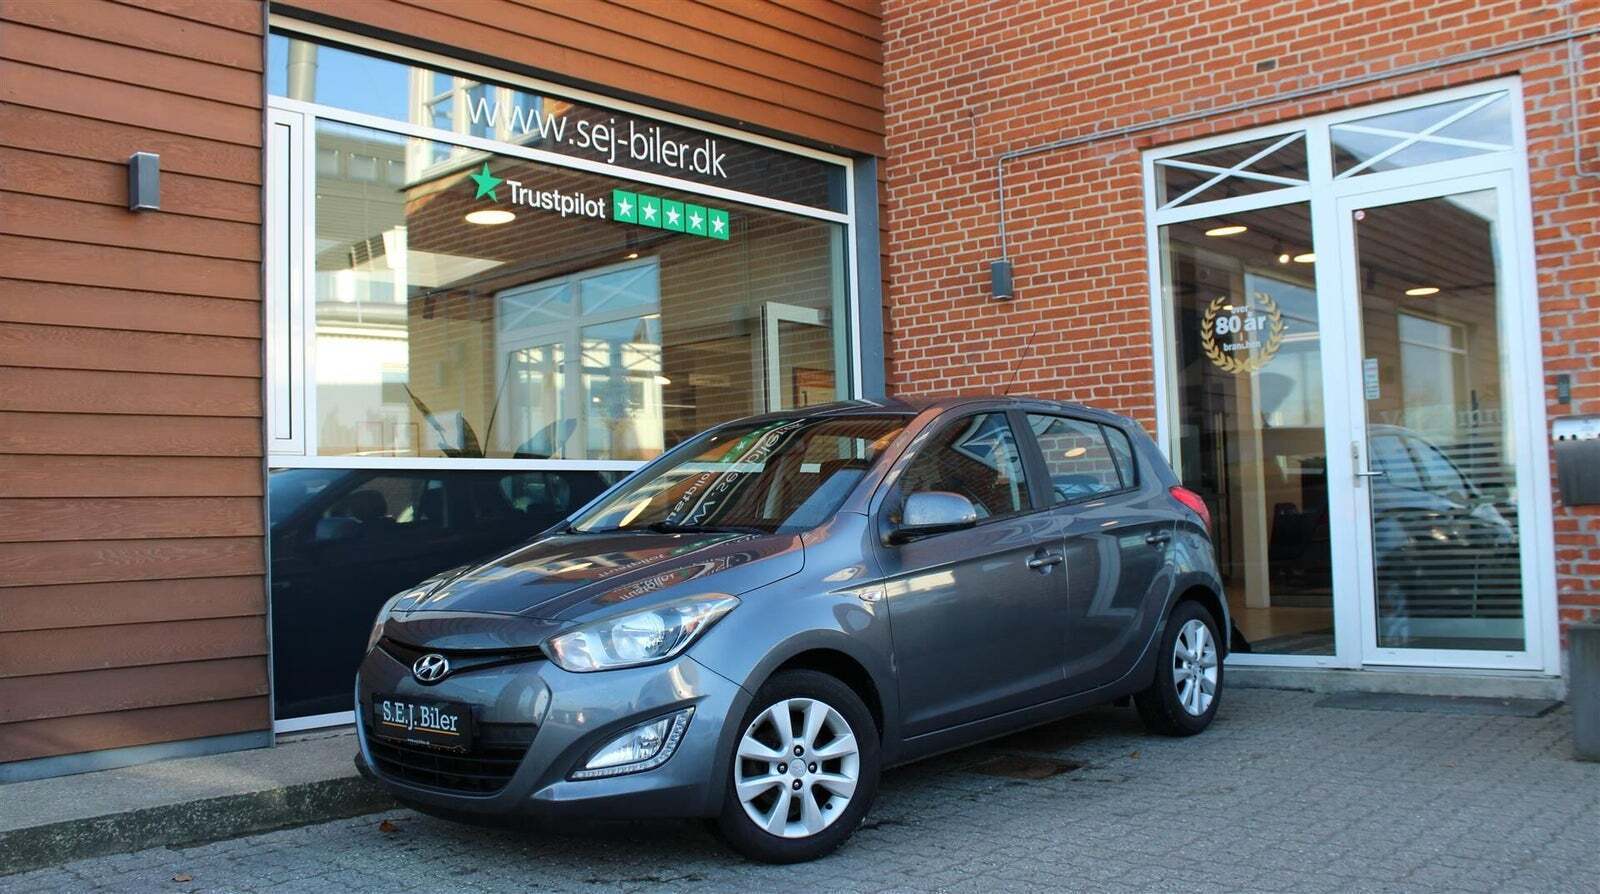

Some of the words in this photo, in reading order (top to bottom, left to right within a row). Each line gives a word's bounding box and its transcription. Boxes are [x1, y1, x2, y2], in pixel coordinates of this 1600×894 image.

[466, 94, 728, 179] www.sej-biler.dk
[506, 180, 606, 219] Trustpilot
[1215, 315, 1241, 335] 80
[1244, 311, 1266, 331] år
[1232, 306, 1248, 314] over
[383, 700, 417, 730] S.E.J.
[420, 706, 458, 731] Biler
